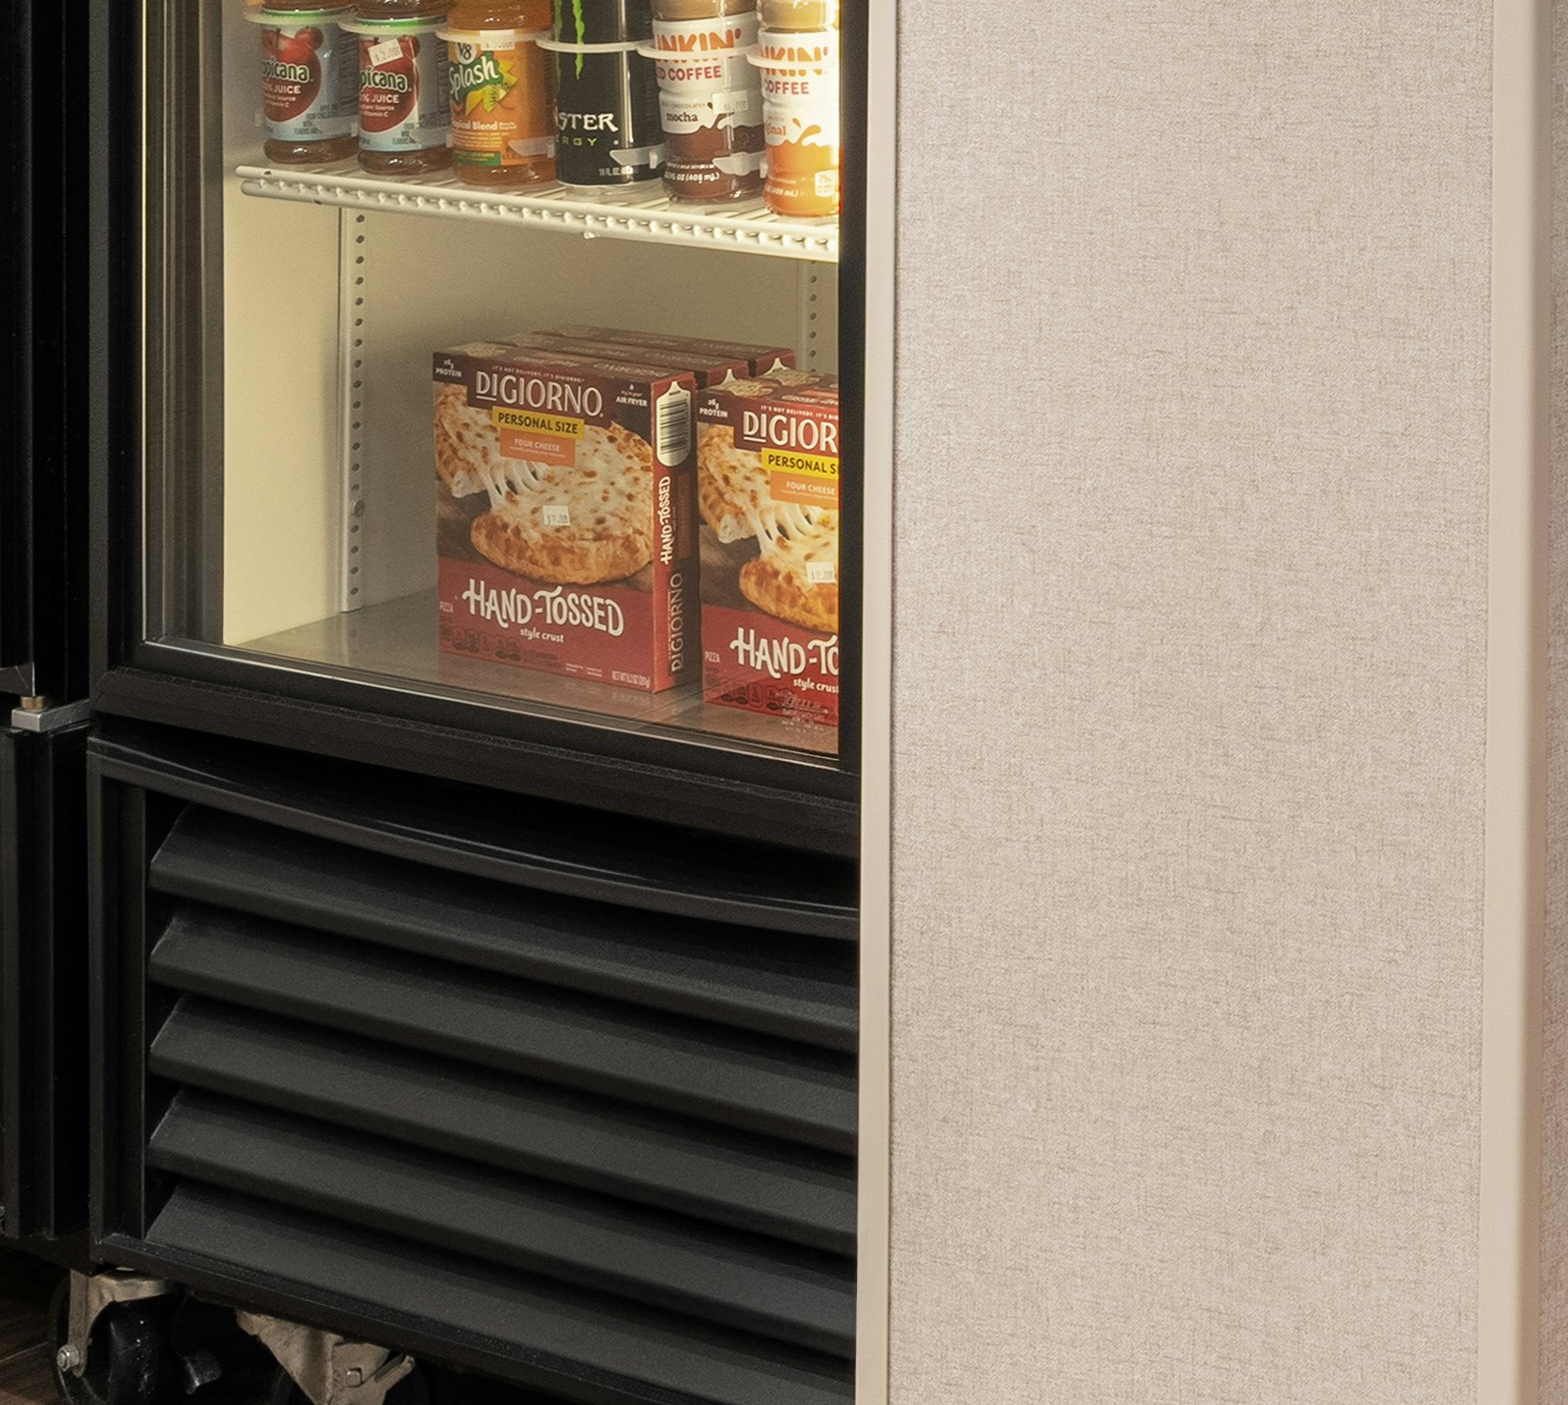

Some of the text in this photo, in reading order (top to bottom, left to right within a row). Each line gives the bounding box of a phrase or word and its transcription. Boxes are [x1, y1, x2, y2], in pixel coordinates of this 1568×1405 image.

[449, 56, 498, 102] Splash
[668, 65, 722, 80] COFFEE
[275, 85, 301, 94] JUICE
[370, 94, 399, 103] JUICE
[666, 111, 698, 124] mocha
[472, 122, 497, 131] Blend
[435, 368, 462, 378] PROTEIN
[628, 398, 648, 407] FRYER
[498, 412, 579, 435] PERSONAL SIZE
[514, 438, 560, 452] FOUR CHEESE
[767, 453, 825, 473] PERSONAL
[461, 577, 625, 637] HAND-TOSSED
[520, 627, 565, 644] style crust
